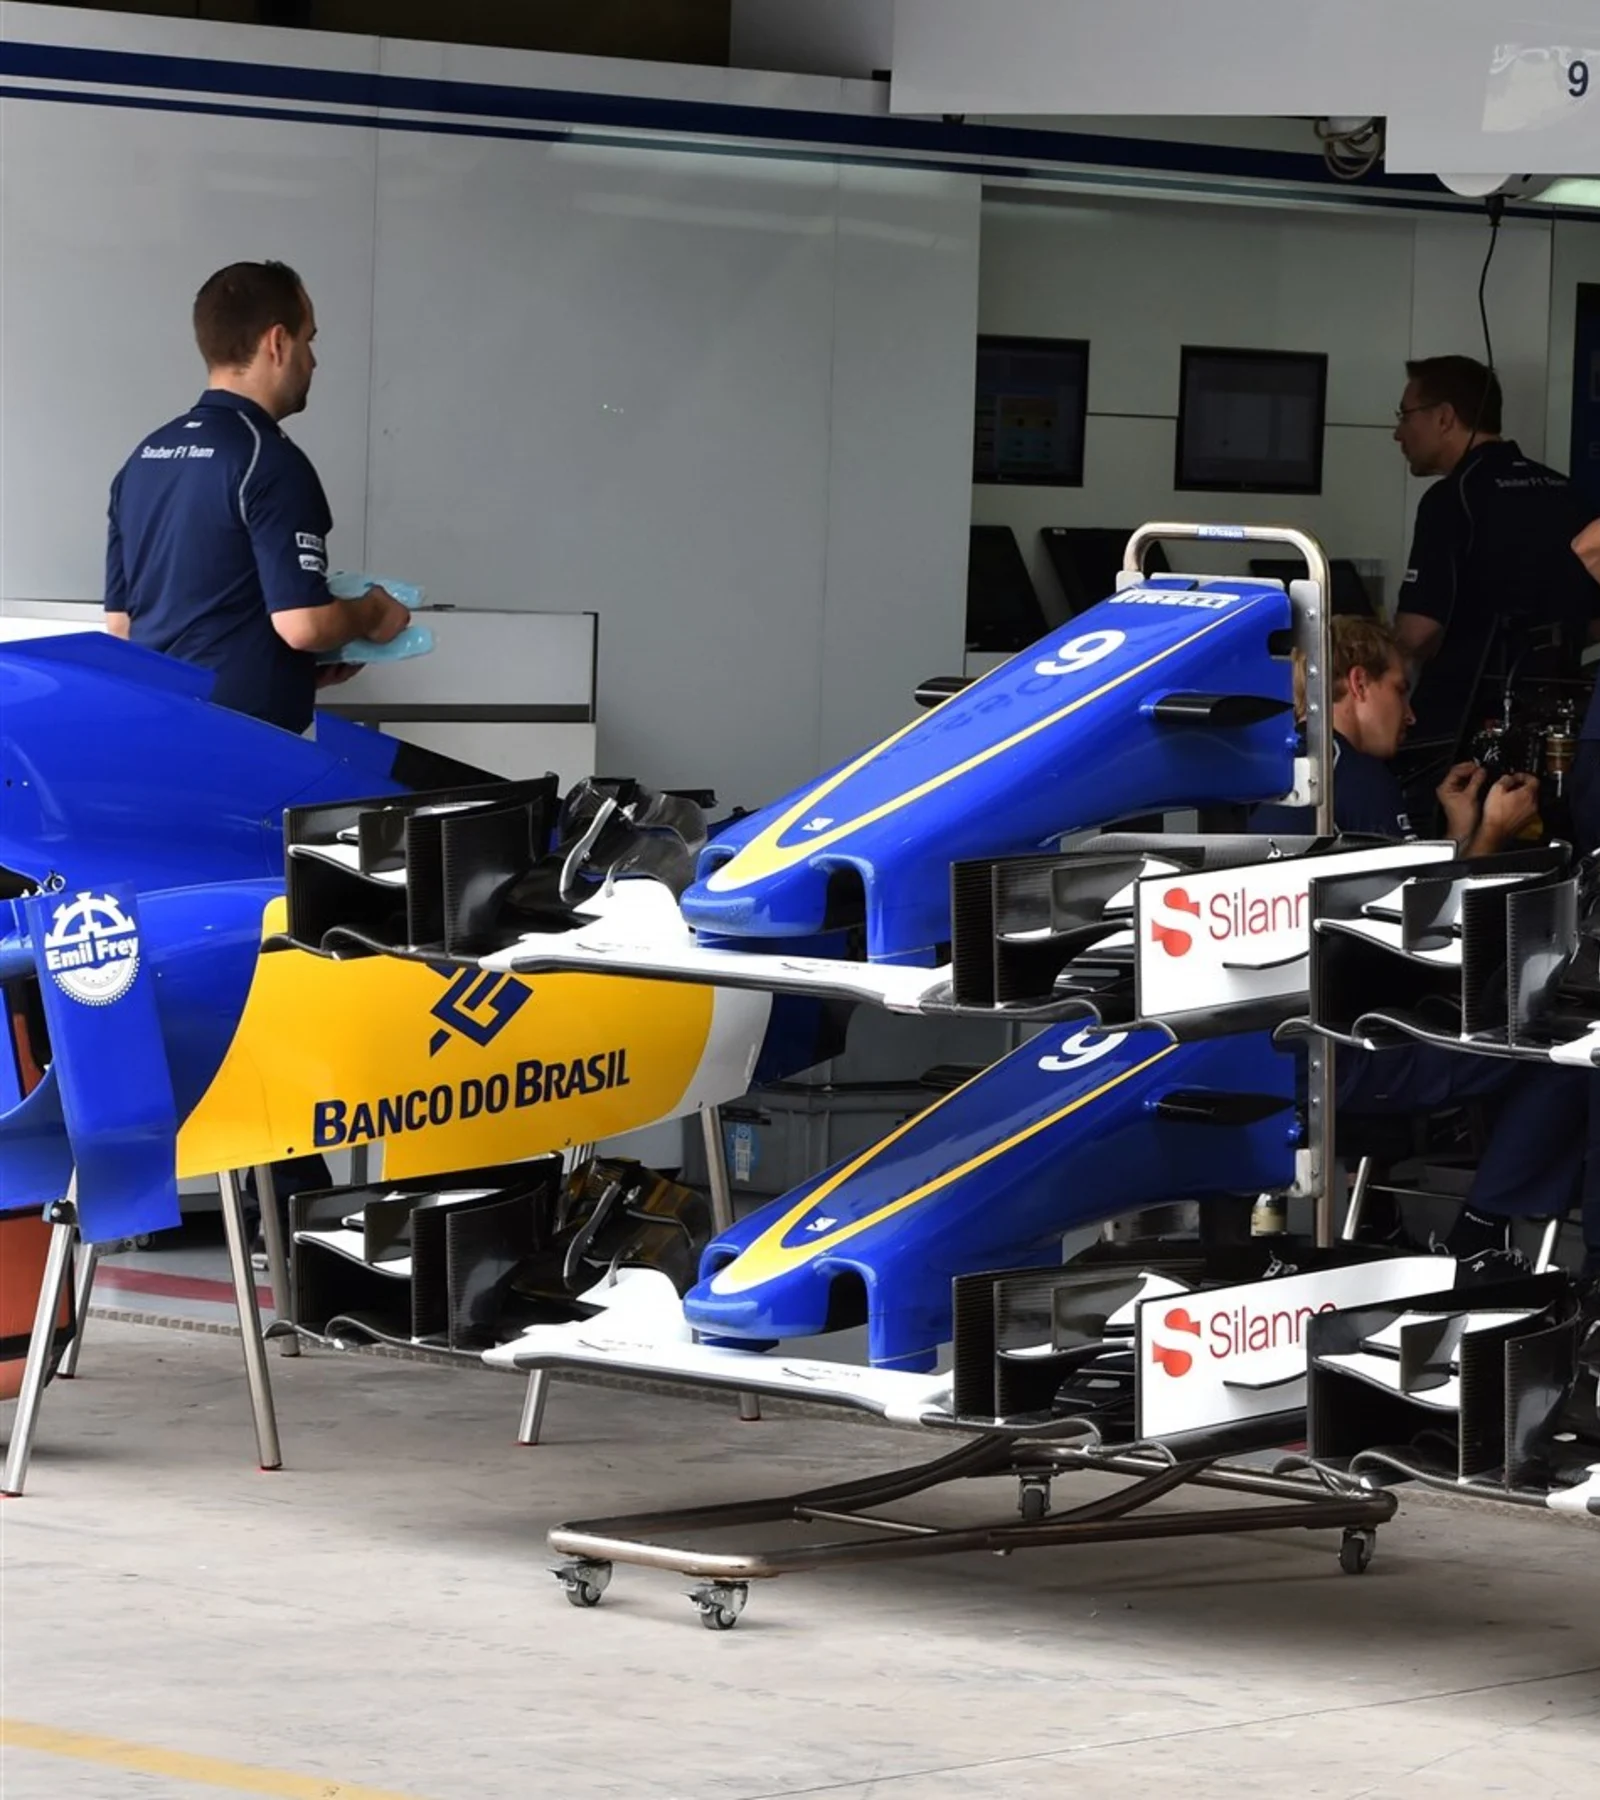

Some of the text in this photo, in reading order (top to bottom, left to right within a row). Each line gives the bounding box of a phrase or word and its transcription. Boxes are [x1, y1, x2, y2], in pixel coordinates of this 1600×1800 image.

[1567, 60, 1589, 97] 9
[141, 445, 175, 459] Sauber
[1107, 588, 1240, 610] PIRELLI
[1035, 629, 1127, 676] 9
[45, 936, 139, 971] Emil Frey
[1038, 1031, 1129, 1071] 9
[313, 1048, 630, 1147] BANCO DO BRASIL
